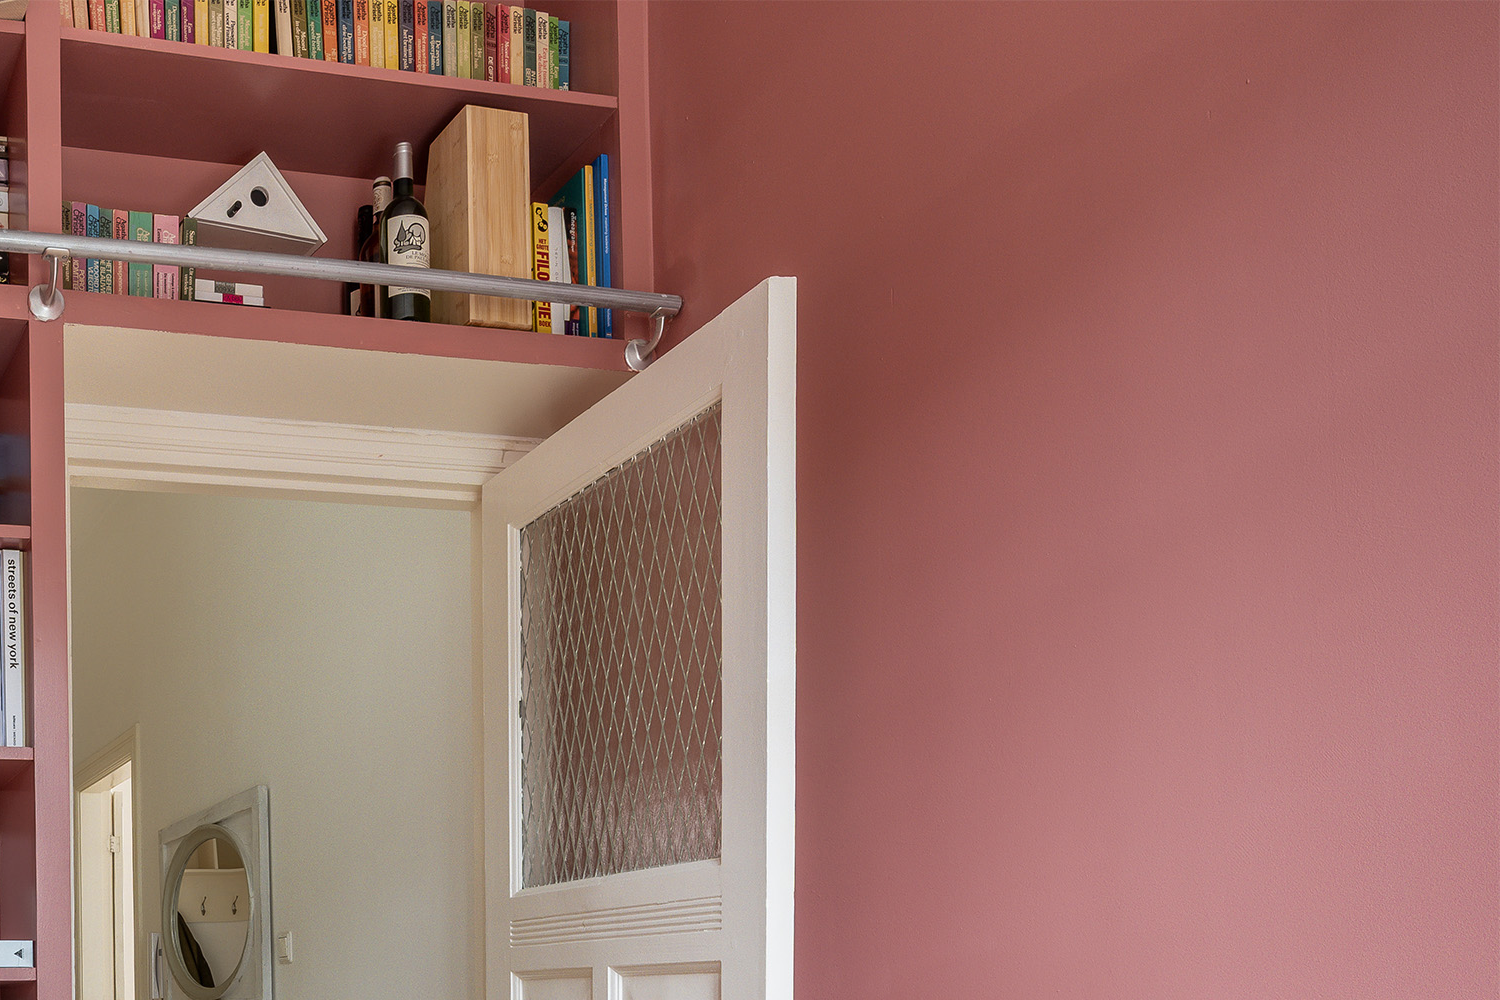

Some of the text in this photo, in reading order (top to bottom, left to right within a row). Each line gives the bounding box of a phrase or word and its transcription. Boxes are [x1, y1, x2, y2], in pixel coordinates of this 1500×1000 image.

[7, 559, 16, 600] streets
[9, 602, 19, 614] of
[8, 643, 19, 669] york
